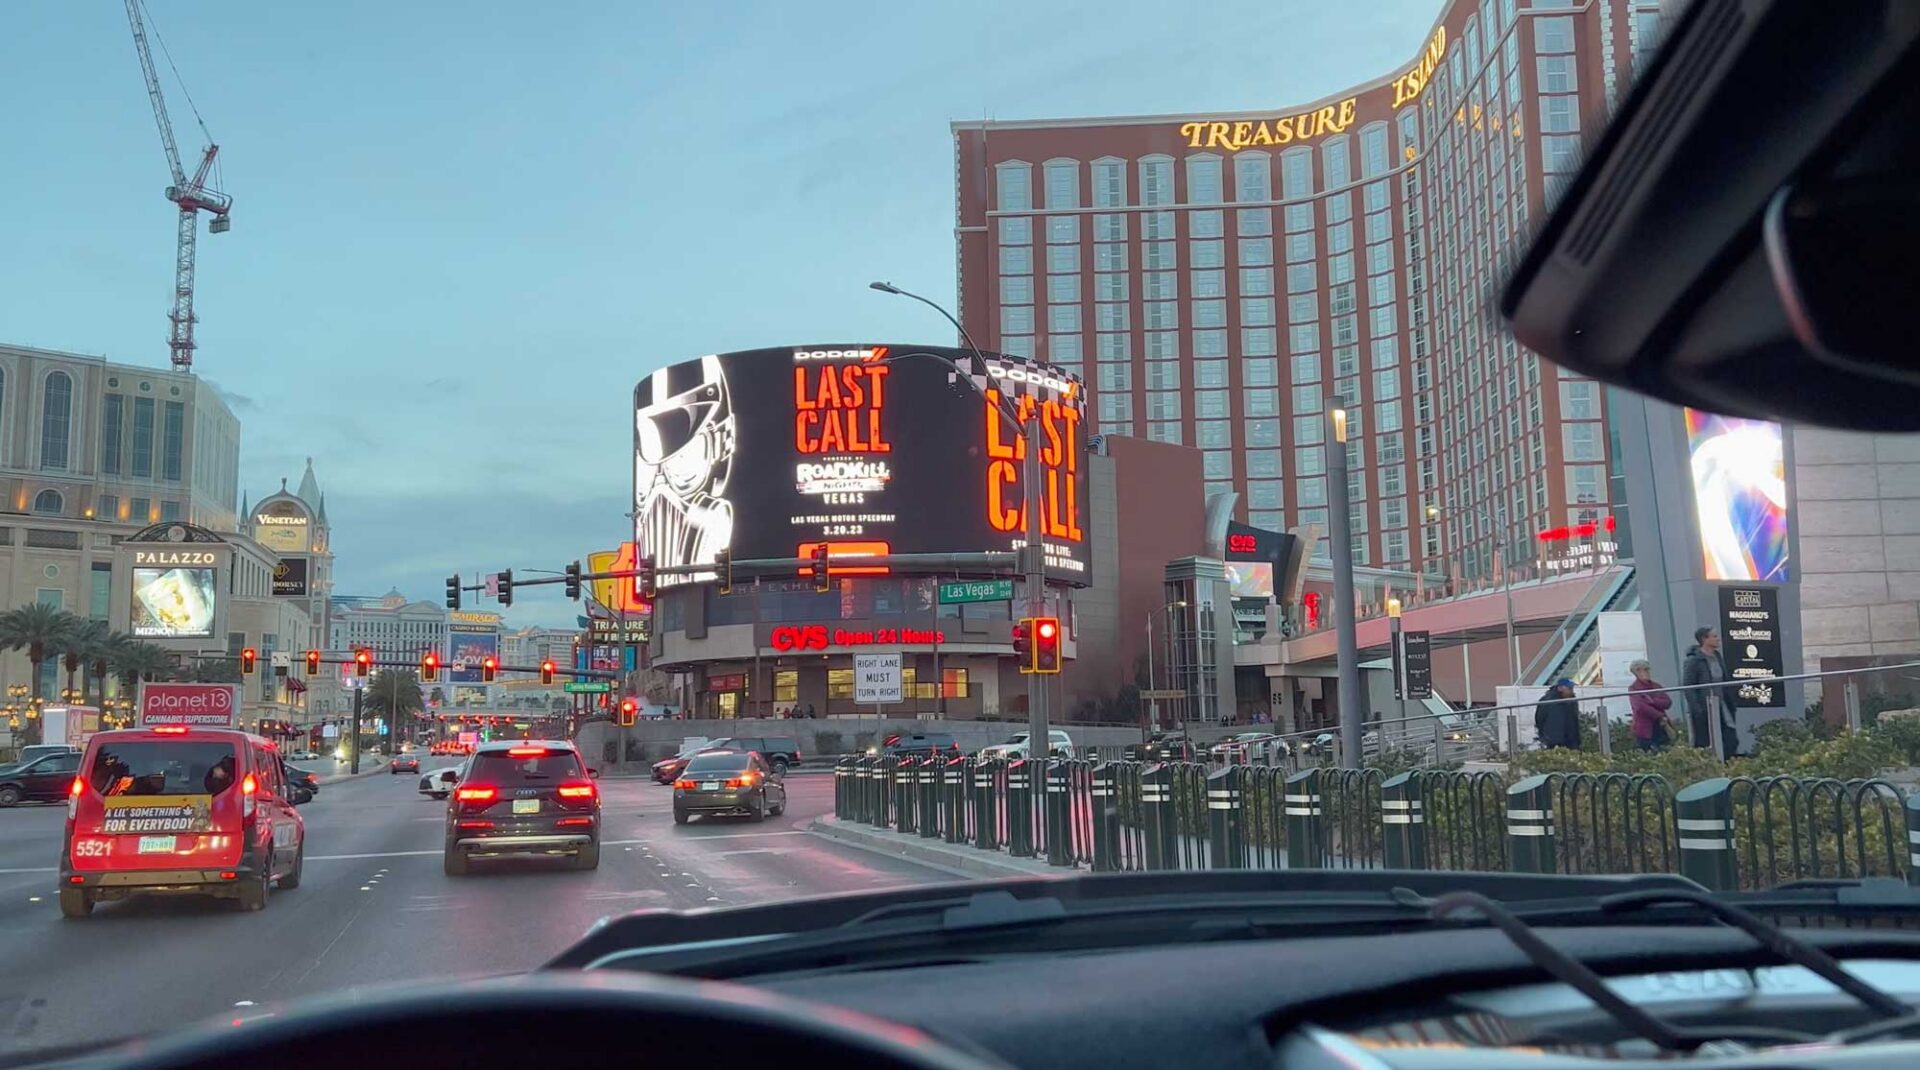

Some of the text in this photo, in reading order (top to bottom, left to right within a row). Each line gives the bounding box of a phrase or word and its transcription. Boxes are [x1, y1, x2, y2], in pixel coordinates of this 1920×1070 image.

[1180, 25, 1446, 150] TREASURE ISLAND
[794, 350, 873, 360] DODGE
[987, 365, 1071, 394] DODGE
[795, 365, 889, 410] LAST
[796, 409, 890, 453] CALL
[796, 461, 890, 482] ROADKILL
[823, 493, 864, 504] VEGAS
[988, 460, 1081, 541] CLL
[257, 514, 307, 525] VENETIAN
[806, 515, 829, 523] VEGAS
[858, 514, 895, 522] SPEEDWAY
[823, 525, 863, 535] 3.20.23
[136, 552, 215, 563] PALAZZO
[947, 585, 963, 598] Las
[965, 583, 994, 599] Vegas
[771, 625, 829, 651] CVS
[834, 629, 873, 645] Open
[877, 629, 897, 643] 24
[857, 660, 899, 668] RIGHT LANE
[866, 673, 890, 682] MUST
[858, 688, 899, 697] TURN RIGHT
[148, 692, 226, 711] planet 13
[145, 714, 229, 723] CANNABIS SUPERSTORE
[105, 807, 181, 817] A LIL' SOMETHING
[105, 818, 194, 831] FOR EVERYBODY
[76, 841, 112, 856] 5521
